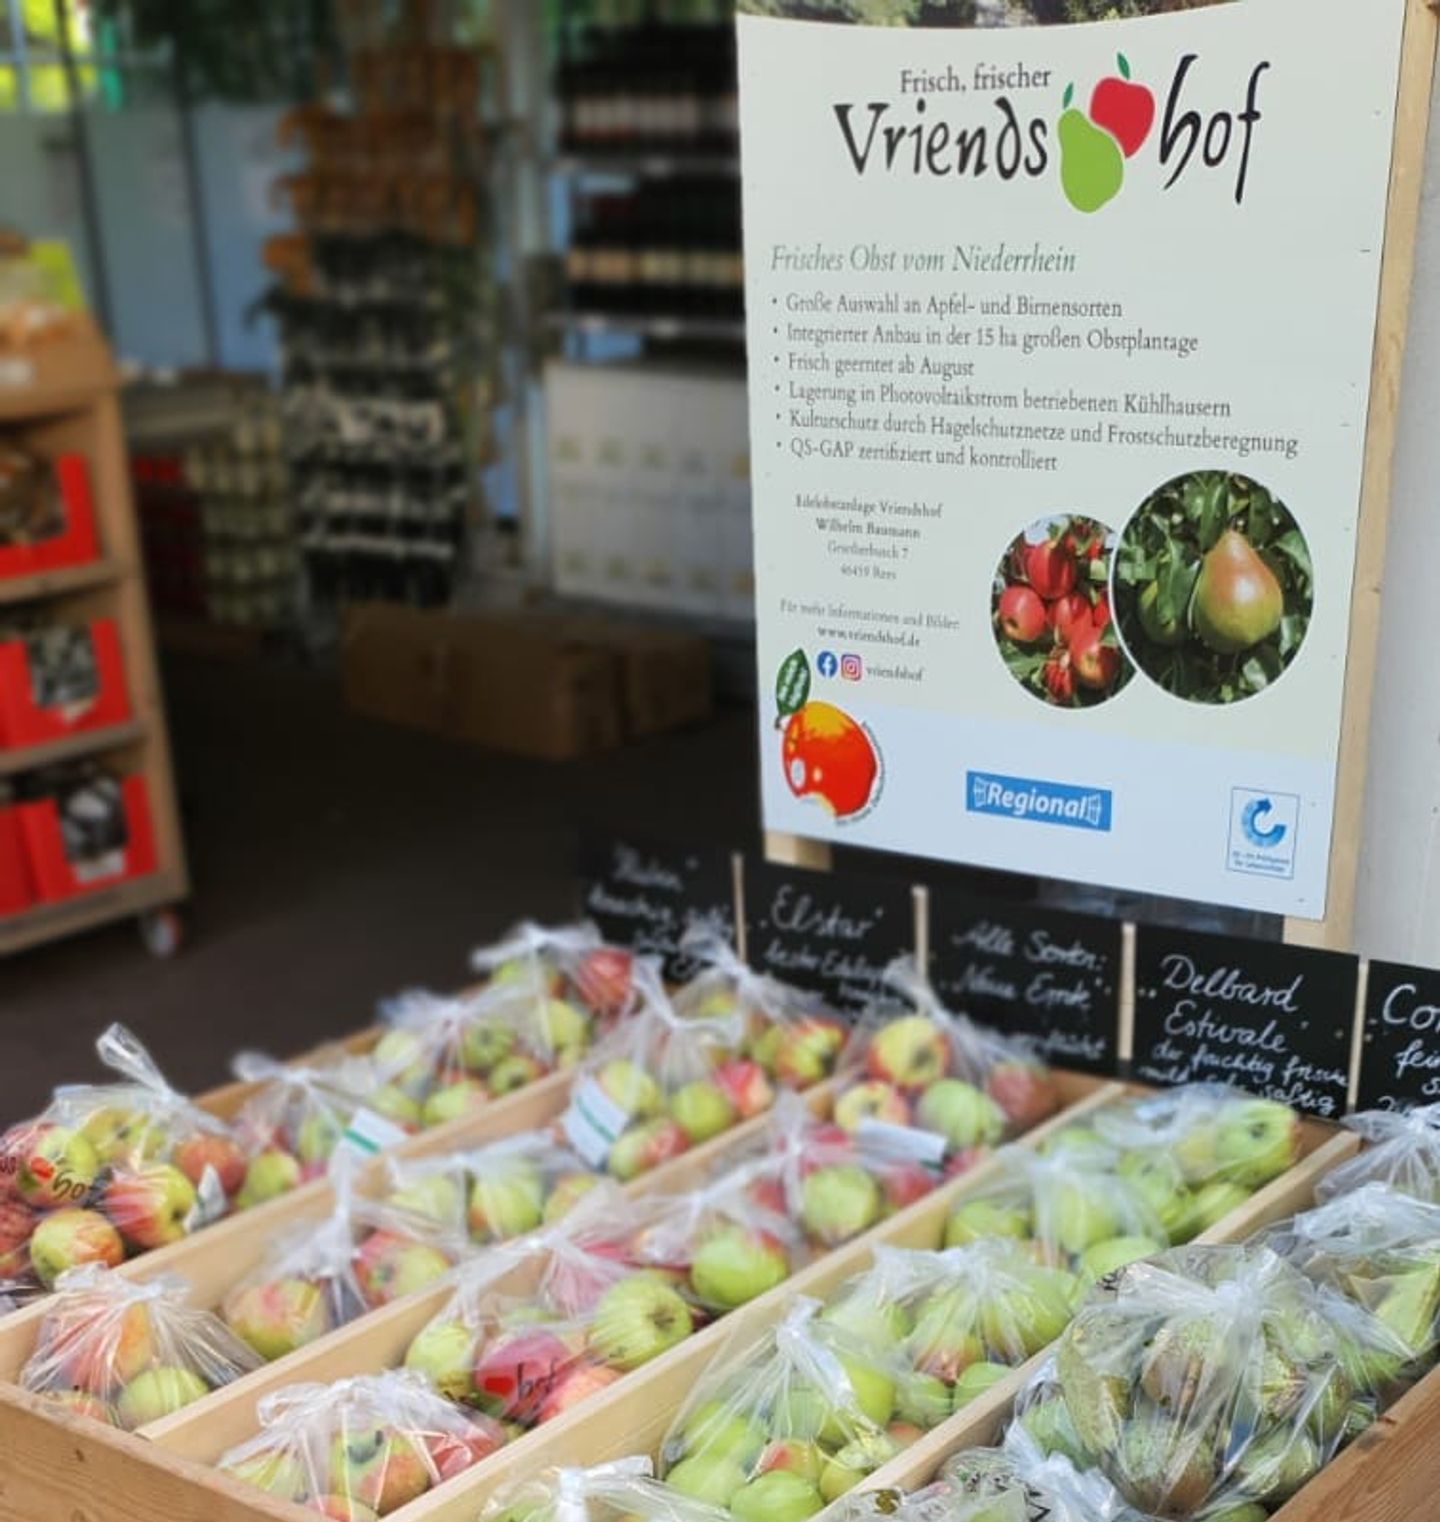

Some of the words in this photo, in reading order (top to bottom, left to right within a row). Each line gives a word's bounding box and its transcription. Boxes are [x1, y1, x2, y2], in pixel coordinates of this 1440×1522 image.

[900, 69, 966, 92] Frisch,
[973, 63, 1051, 91] frischer
[834, 97, 1048, 180] Vriends
[1159, 54, 1270, 204] hof
[771, 243, 843, 272] Frisches
[851, 243, 897, 272] Obst
[903, 251, 944, 272] vom
[953, 243, 1076, 273] Niederrhein
[786, 291, 831, 314] Große
[837, 293, 899, 315] Auswahl
[903, 301, 921, 315] an
[927, 292, 975, 320] Apfel-
[981, 294, 1011, 316] und
[1017, 295, 1122, 318] Birnensorten
[788, 323, 868, 348] Integrierter
[873, 325, 921, 345] Anbau
[926, 326, 941, 345] in
[946, 325, 969, 346] der
[977, 327, 994, 347] 15
[1000, 325, 1017, 348] ha
[1023, 324, 1081, 354] großen
[1087, 327, 1199, 358] Obstplantage
[789, 352, 829, 372] Frisch
[835, 355, 894, 378] geerntet
[899, 353, 914, 374] ab
[920, 356, 974, 380] August
[789, 381, 856, 406] Lagerung
[861, 383, 875, 401] in
[880, 383, 1018, 409] Photovoltaikstrom
[1023, 388, 1118, 413] betriebenen
[789, 408, 878, 432] Kulturschutz
[883, 412, 926, 434] durch
[931, 415, 1065, 442] Hagelschutznetze
[1070, 422, 1102, 443] und
[1108, 424, 1298, 459] Frostschutzberegnung
[791, 438, 855, 459] QS-GAP
[858, 441, 932, 465] zertifiziert
[936, 445, 965, 467] und
[970, 447, 1058, 472] kontrolliert
[880, 500, 943, 519] Vriendshof
[815, 516, 863, 535] Wilhelm
[867, 521, 921, 539] Baumann
[828, 602, 900, 625] Informationen
[903, 612, 922, 627] und
[986, 780, 1088, 821] Regional
[1161, 953, 1304, 1014] Delbard
[1382, 983, 1440, 1033] Co
[1163, 1000, 1288, 1054] Estivale
